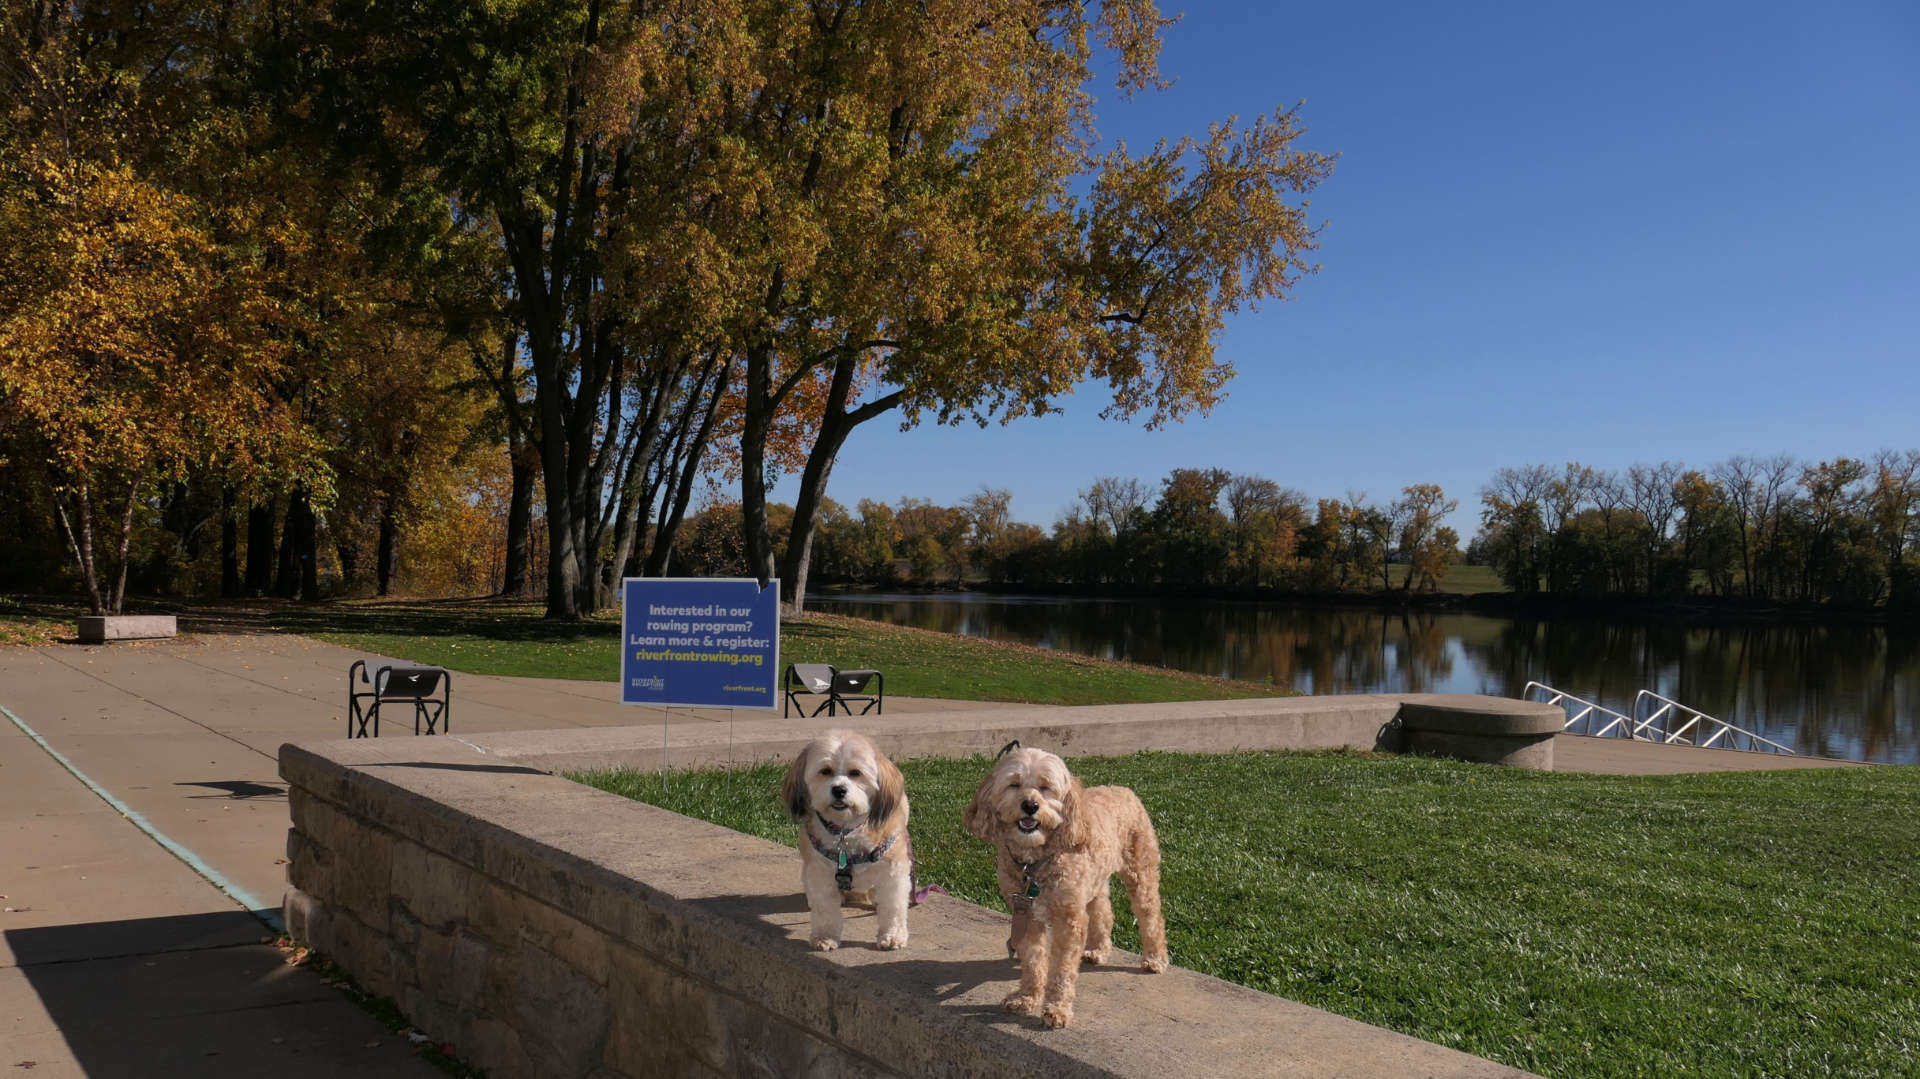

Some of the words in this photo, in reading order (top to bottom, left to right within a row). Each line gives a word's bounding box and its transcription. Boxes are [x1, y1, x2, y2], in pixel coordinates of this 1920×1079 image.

[650, 604, 712, 616] Interested
[715, 605, 726, 616] in
[730, 608, 751, 616] our
[647, 620, 689, 633] rowing
[692, 621, 753, 634] program?
[631, 634, 665, 645] Learn
[669, 638, 700, 646] more
[703, 636, 713, 646] &
[716, 636, 770, 649] register:
[636, 649, 763, 665] riverfrontrowing.org
